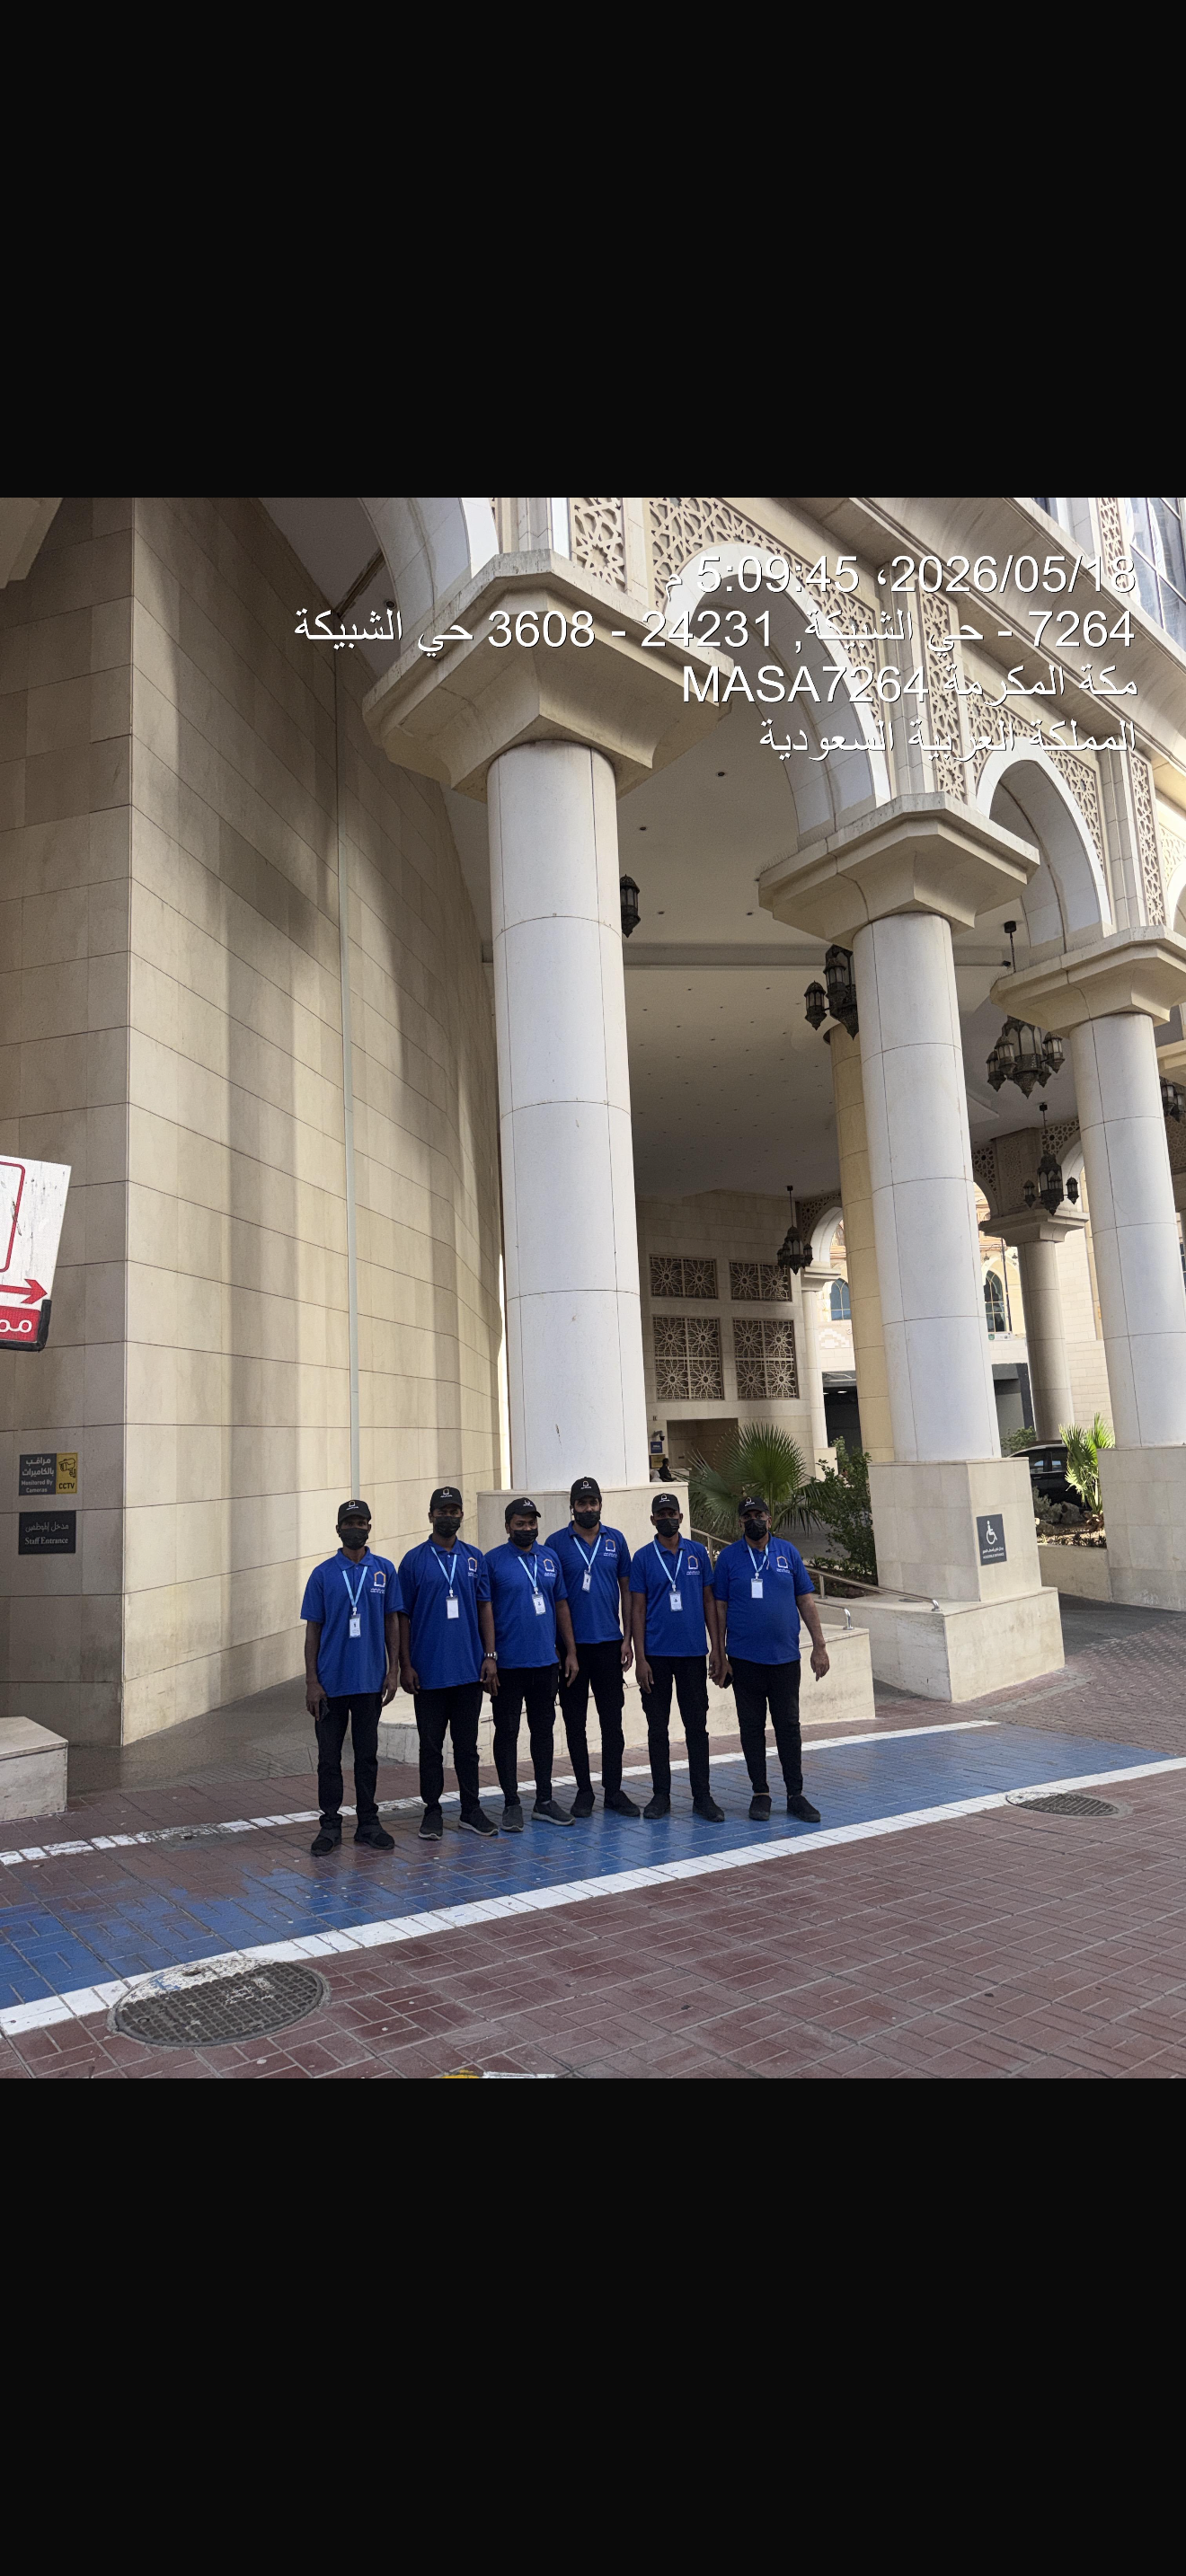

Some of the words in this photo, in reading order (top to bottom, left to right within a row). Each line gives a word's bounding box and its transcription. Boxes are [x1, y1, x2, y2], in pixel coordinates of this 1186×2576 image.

[25, 1457, 51, 1466] مراقب
[22, 1467, 54, 1477] بالكاميرات
[50, 1522, 69, 1532] مدخل
